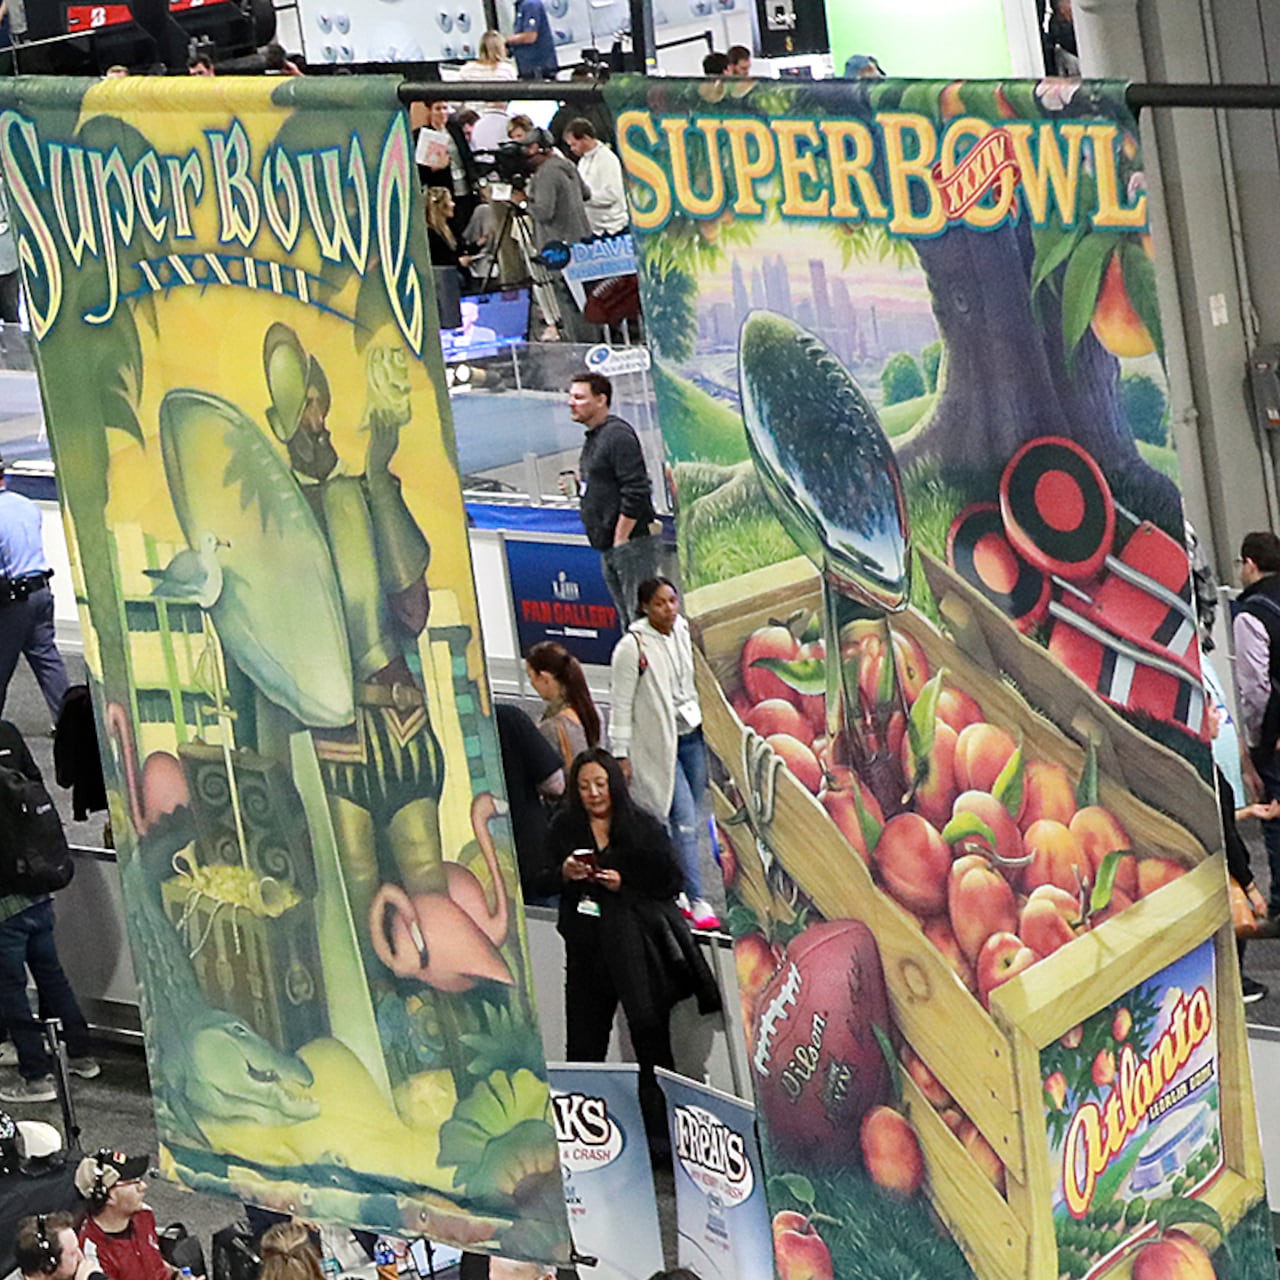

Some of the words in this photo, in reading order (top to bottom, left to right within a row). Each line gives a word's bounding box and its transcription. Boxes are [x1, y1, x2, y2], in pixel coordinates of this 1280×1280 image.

[942, 135, 1008, 216] XXXIV
[203, 107, 425, 360] Bowl
[1064, 986, 1212, 1219] Atlanta
[1148, 1081, 1189, 1120] GEORGIA
[572, 1148, 611, 1161] CRASH
[674, 1104, 747, 1183] FREAKS
